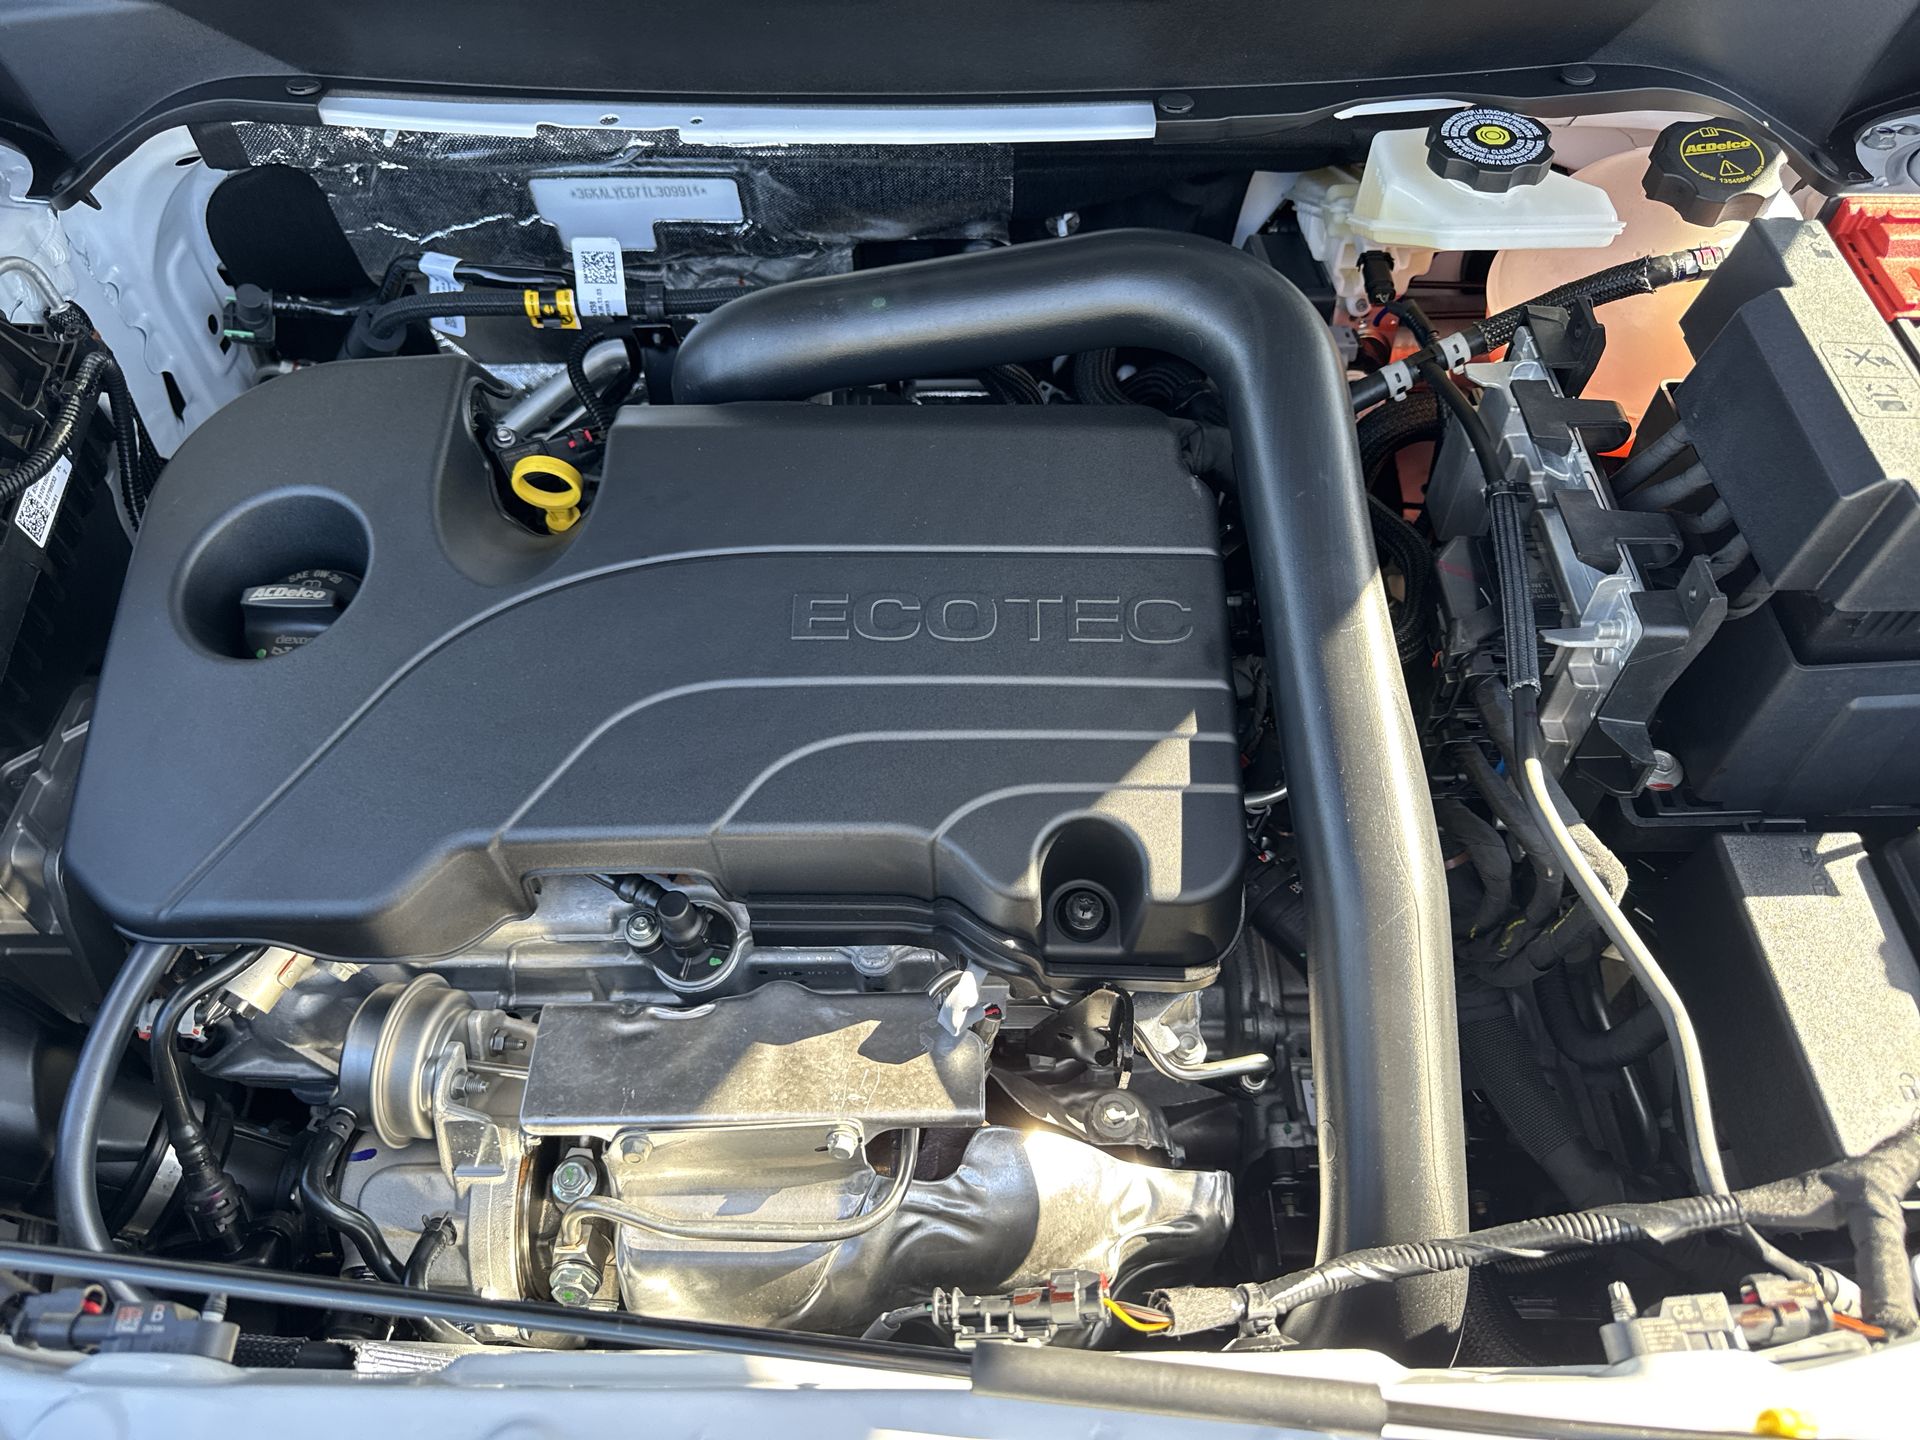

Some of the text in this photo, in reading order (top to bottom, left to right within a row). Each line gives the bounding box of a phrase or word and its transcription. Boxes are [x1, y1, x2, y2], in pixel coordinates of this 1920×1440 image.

[1685, 140, 1752, 154] ACDelco
[288, 571, 309, 582] SAE
[250, 586, 327, 599] ACDelco
[790, 593, 1194, 644] ECOTEC
